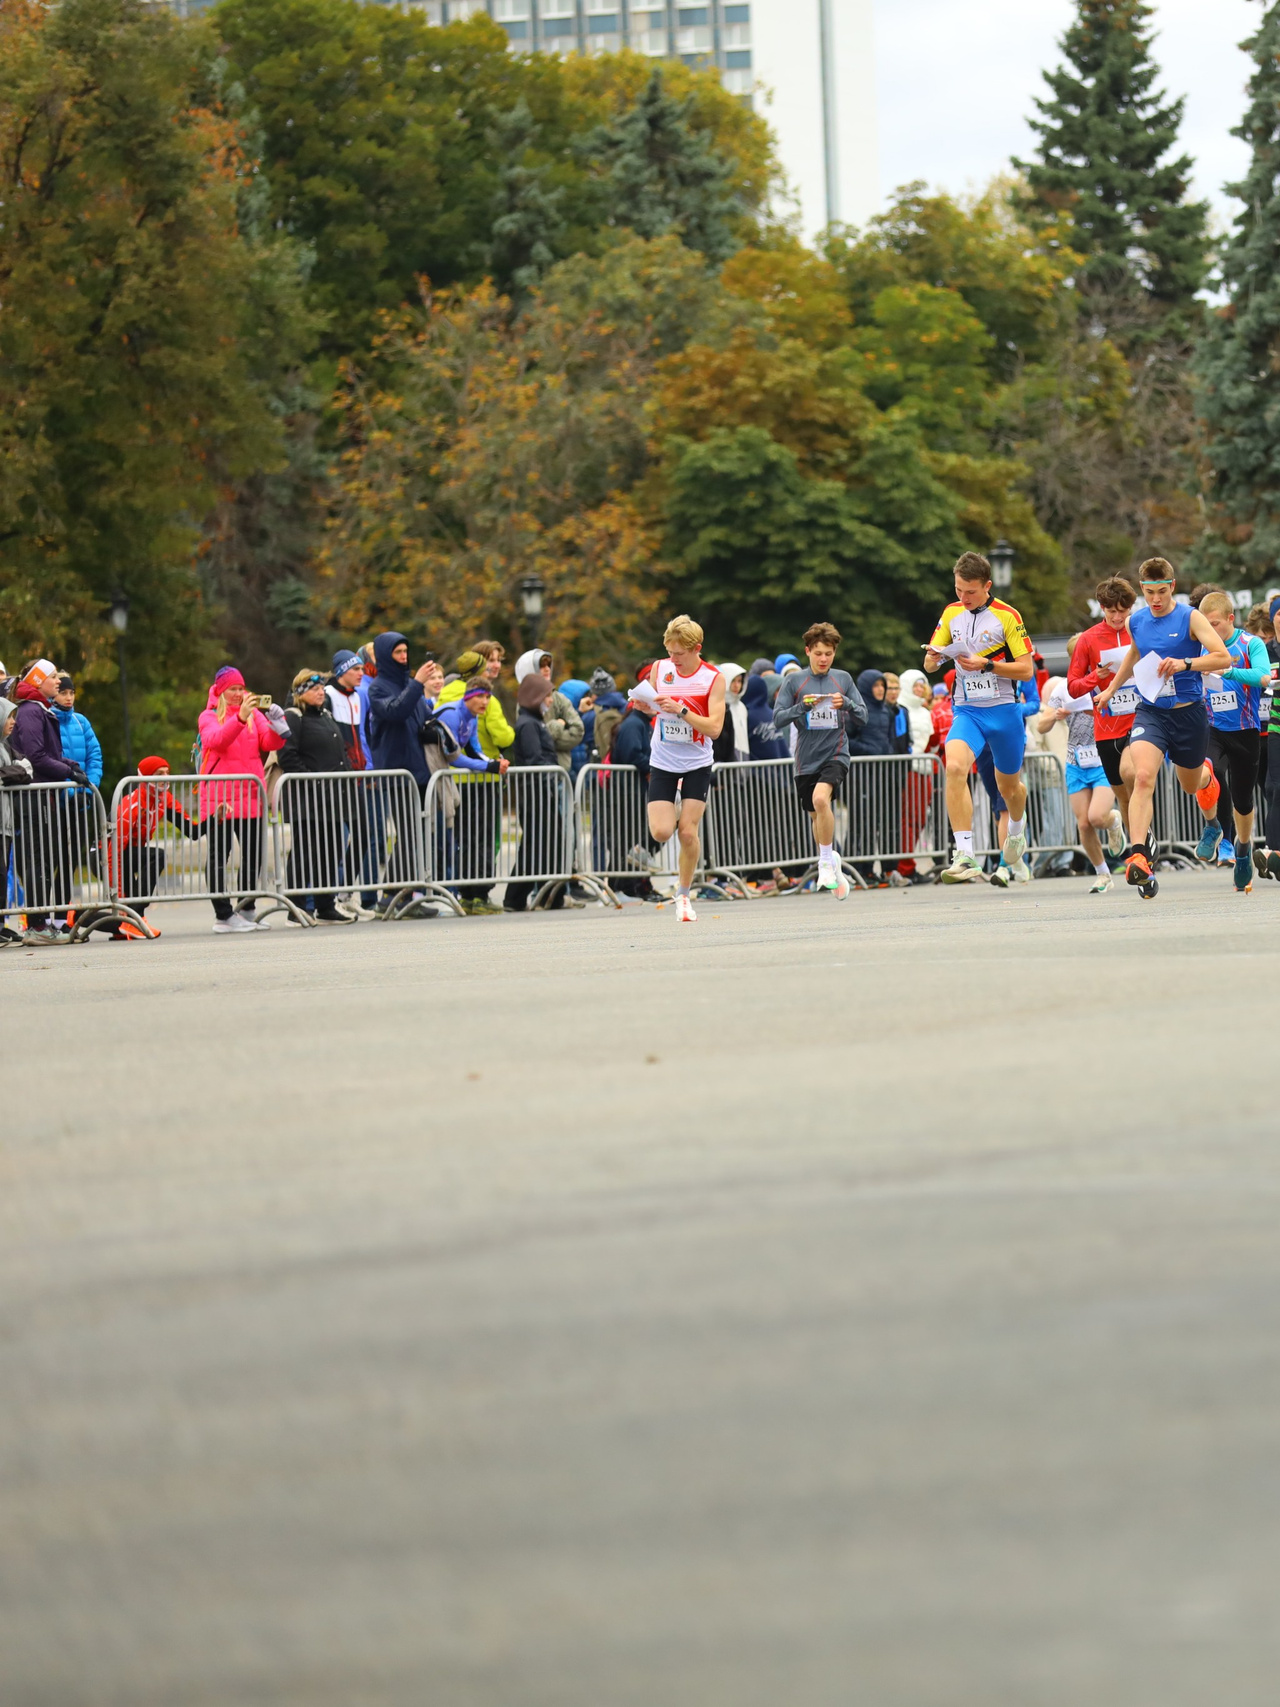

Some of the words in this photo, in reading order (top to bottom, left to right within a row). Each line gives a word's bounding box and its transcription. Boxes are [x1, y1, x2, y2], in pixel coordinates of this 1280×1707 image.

[966, 679, 991, 691] 236.1
[1111, 693, 1136, 705] 232.1
[1211, 693, 1236, 706] 225.1
[810, 711, 833, 720] 234.1
[665, 725, 688, 735] 229.1
